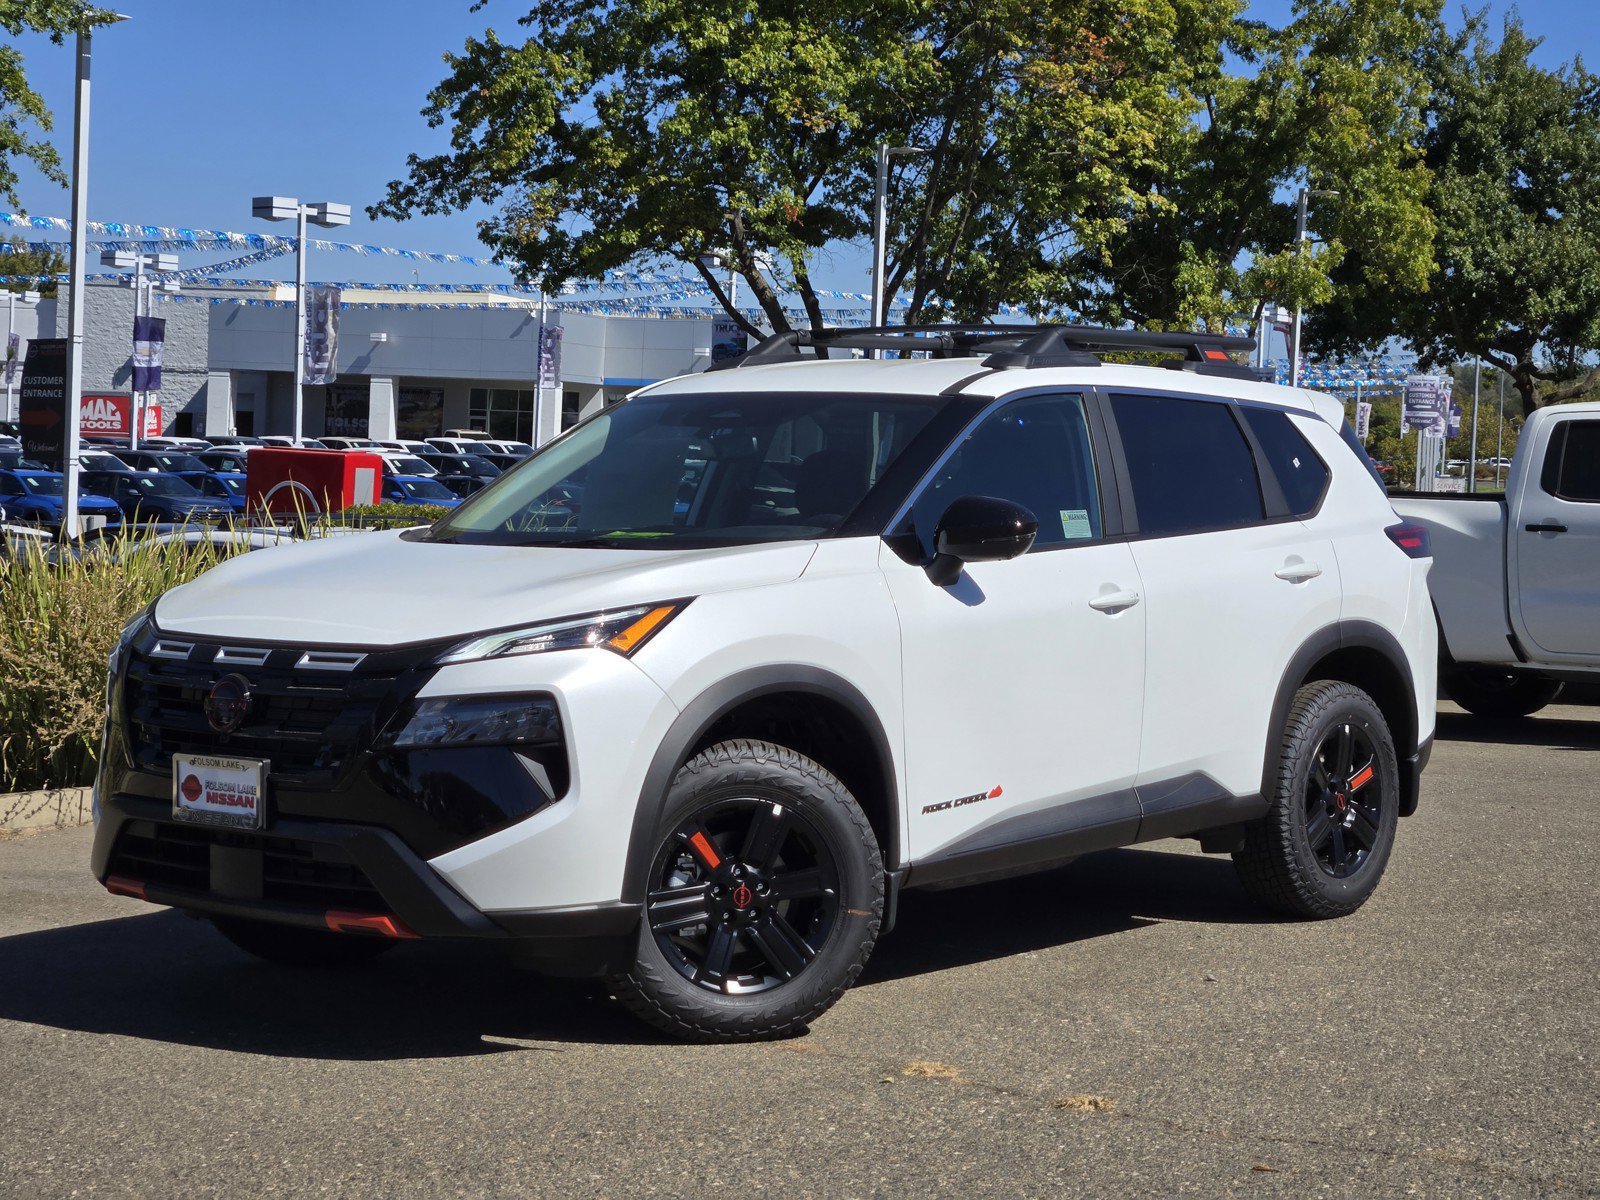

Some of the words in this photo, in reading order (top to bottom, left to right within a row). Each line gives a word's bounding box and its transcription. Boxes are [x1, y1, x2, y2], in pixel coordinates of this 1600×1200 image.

[23, 376, 64, 384] CUSTOMER
[23, 389, 62, 398] ENTRANCE
[80, 398, 122, 422] MAC
[80, 421, 122, 429] TOOLS
[328, 417, 368, 428] FOLSO
[194, 757, 220, 767] FOLSOM
[222, 759, 240, 769] LAKE
[205, 780, 236, 793] FOLSOM
[238, 784, 256, 796] LAKE
[206, 792, 254, 808] NISSAN
[922, 800, 953, 815] ROCK
[954, 792, 988, 808] CREEK
